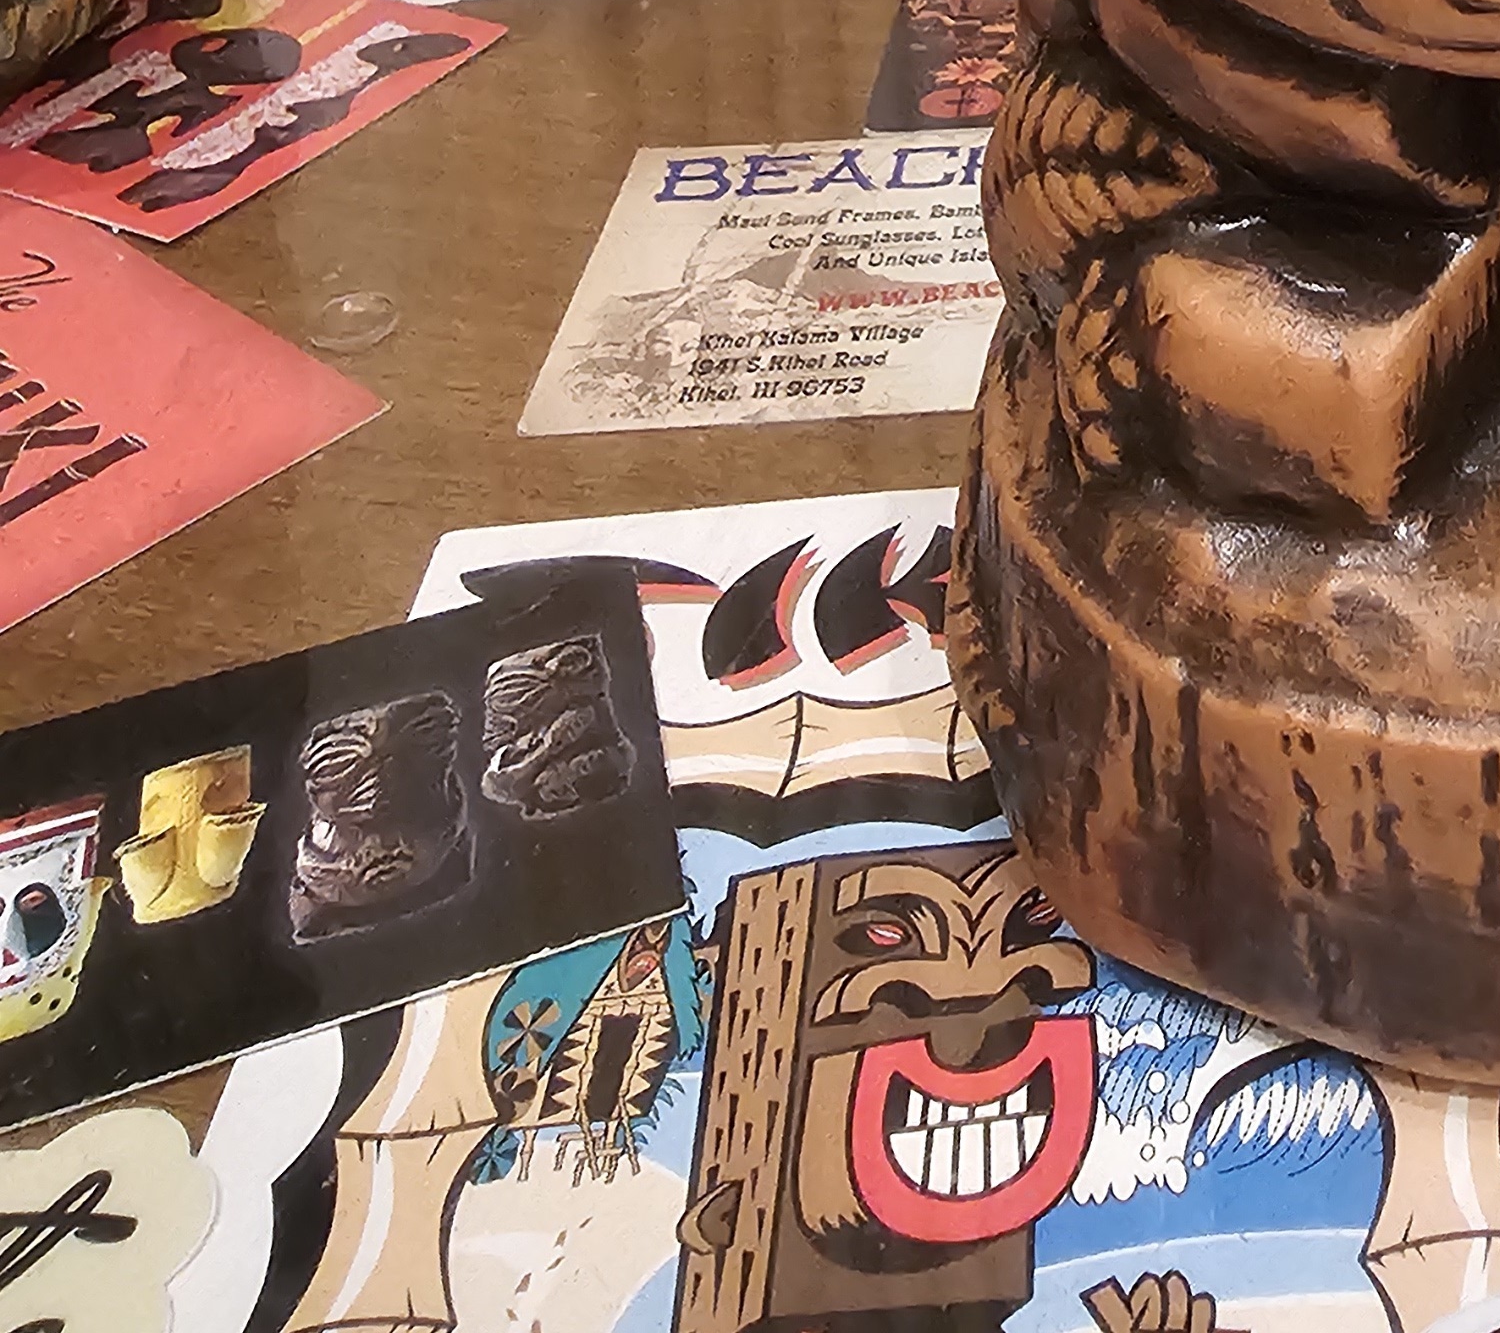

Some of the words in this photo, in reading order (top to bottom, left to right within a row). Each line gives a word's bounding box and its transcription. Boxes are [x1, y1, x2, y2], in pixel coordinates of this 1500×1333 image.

[717, 211, 772, 230] Maui
[774, 207, 833, 228] Sand
[767, 233, 814, 251] Cool
[812, 252, 861, 272] And
[949, 245, 990, 263] Isla
[817, 280, 1001, 313] WWW.BEAC
[758, 327, 840, 349] Kalama
[848, 324, 925, 344] Village
[688, 356, 738, 377] 1941
[832, 348, 889, 369] Road
[751, 381, 779, 400] HI
[786, 375, 866, 398] 96753
